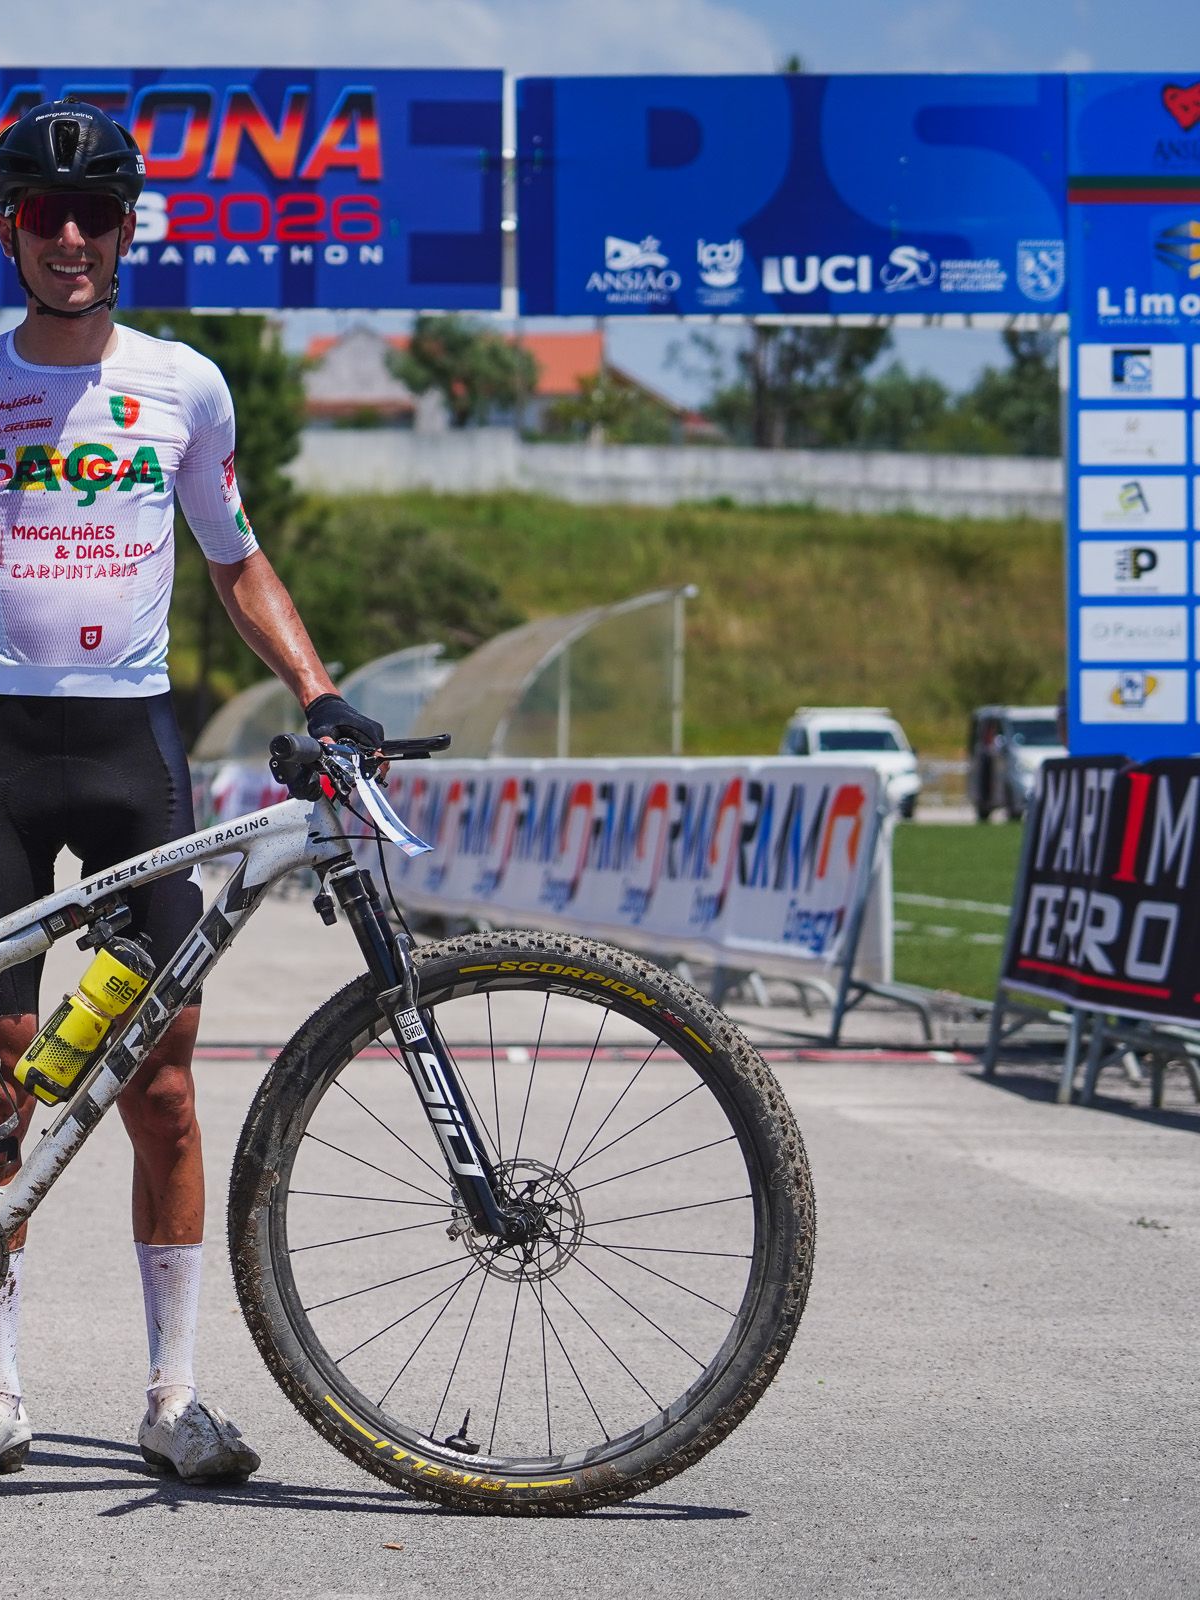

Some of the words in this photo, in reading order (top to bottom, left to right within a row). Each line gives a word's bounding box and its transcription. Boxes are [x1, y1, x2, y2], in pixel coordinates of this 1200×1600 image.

[165, 193, 383, 241] 2026
[121, 244, 384, 265] MARATHON
[587, 270, 681, 292] ANSIÃO
[3, 421, 52, 433] CICLISMO
[11, 522, 116, 541] MAGALHÃES
[54, 545, 71, 560] &
[76, 544, 120, 559] DIAS,
[10, 563, 138, 580] CARPINTARIA
[81, 859, 149, 896] TREK
[151, 836, 213, 868] FACTORY
[215, 816, 270, 844] RACING
[1020, 884, 1180, 982] FERRO
[497, 960, 657, 1007] SCORPION
[546, 983, 614, 1005] ZIPP
[52, 855, 268, 1136] TREK
